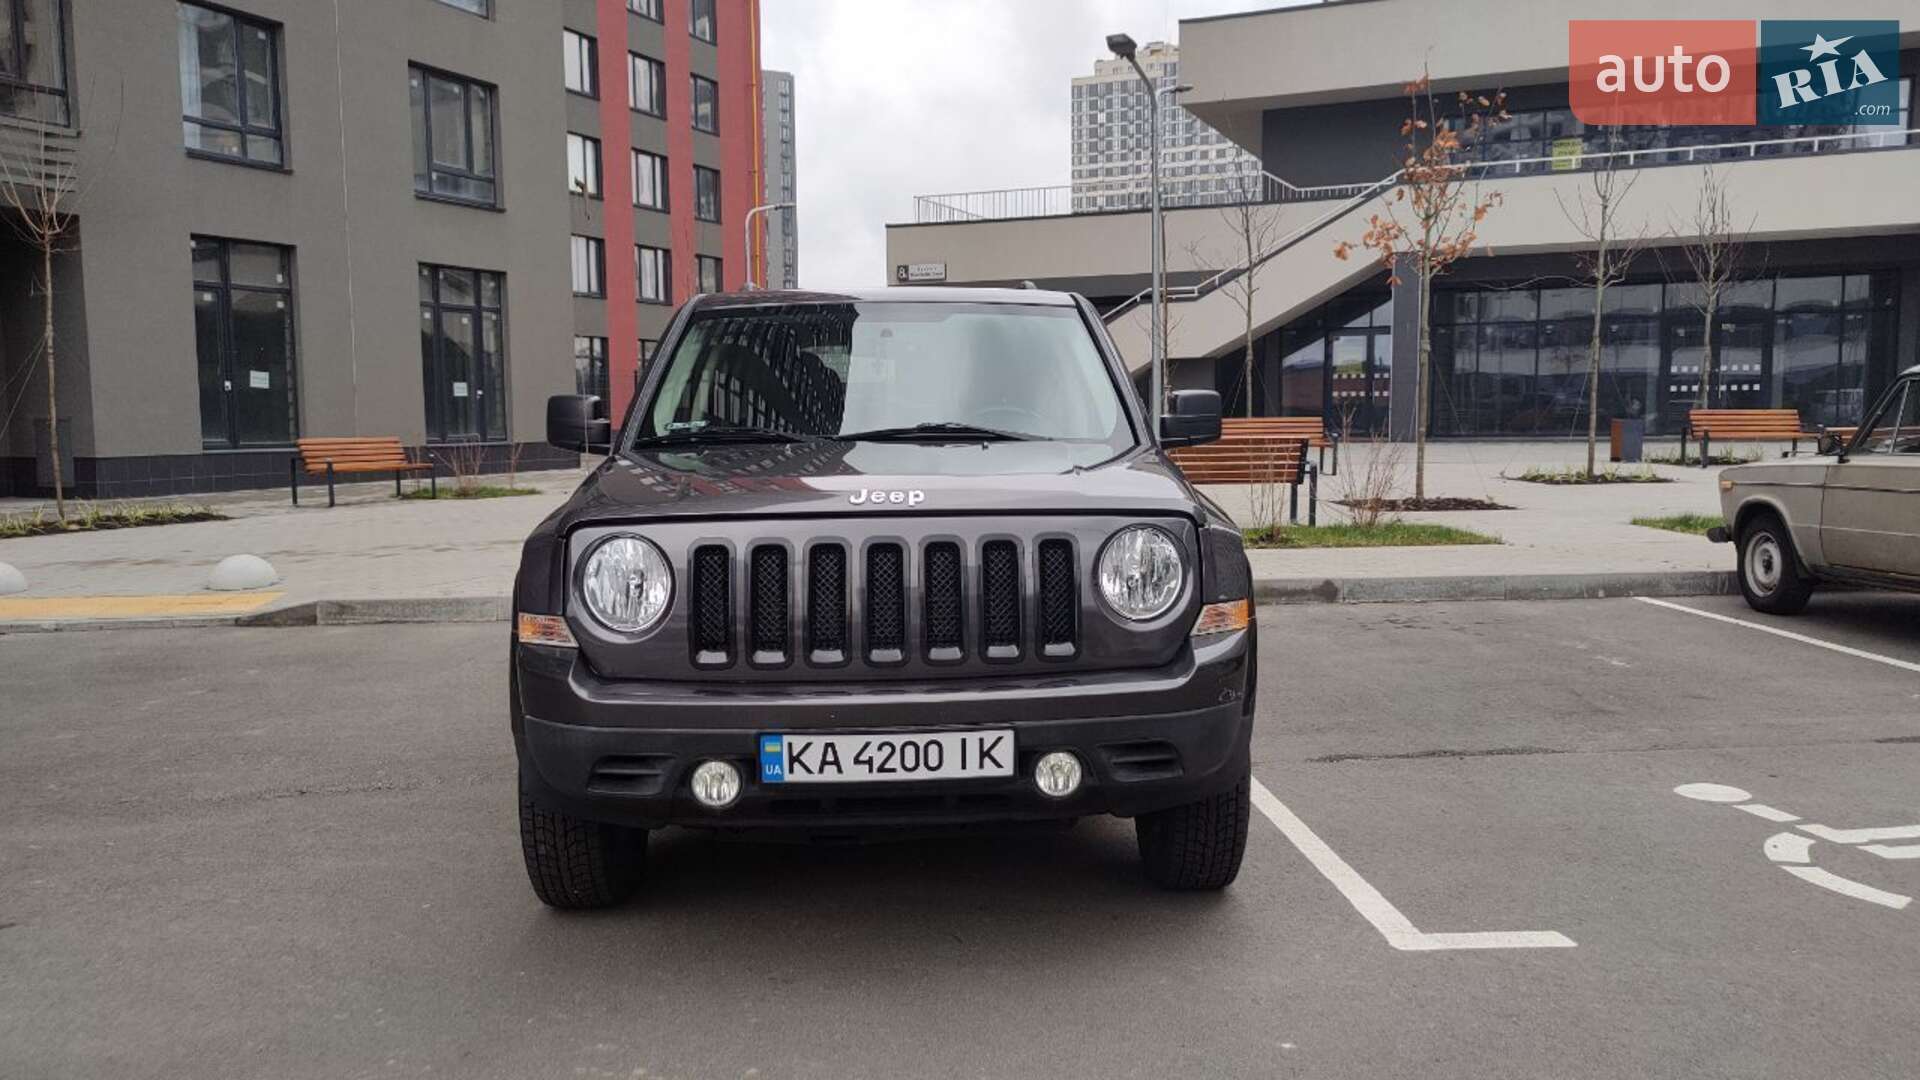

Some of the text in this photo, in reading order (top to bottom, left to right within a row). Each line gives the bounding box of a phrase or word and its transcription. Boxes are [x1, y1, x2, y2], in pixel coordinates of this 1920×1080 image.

[849, 488, 925, 507] Jeep
[787, 741, 844, 775] KA
[853, 739, 944, 774] 4200
[765, 764, 783, 776] UA
